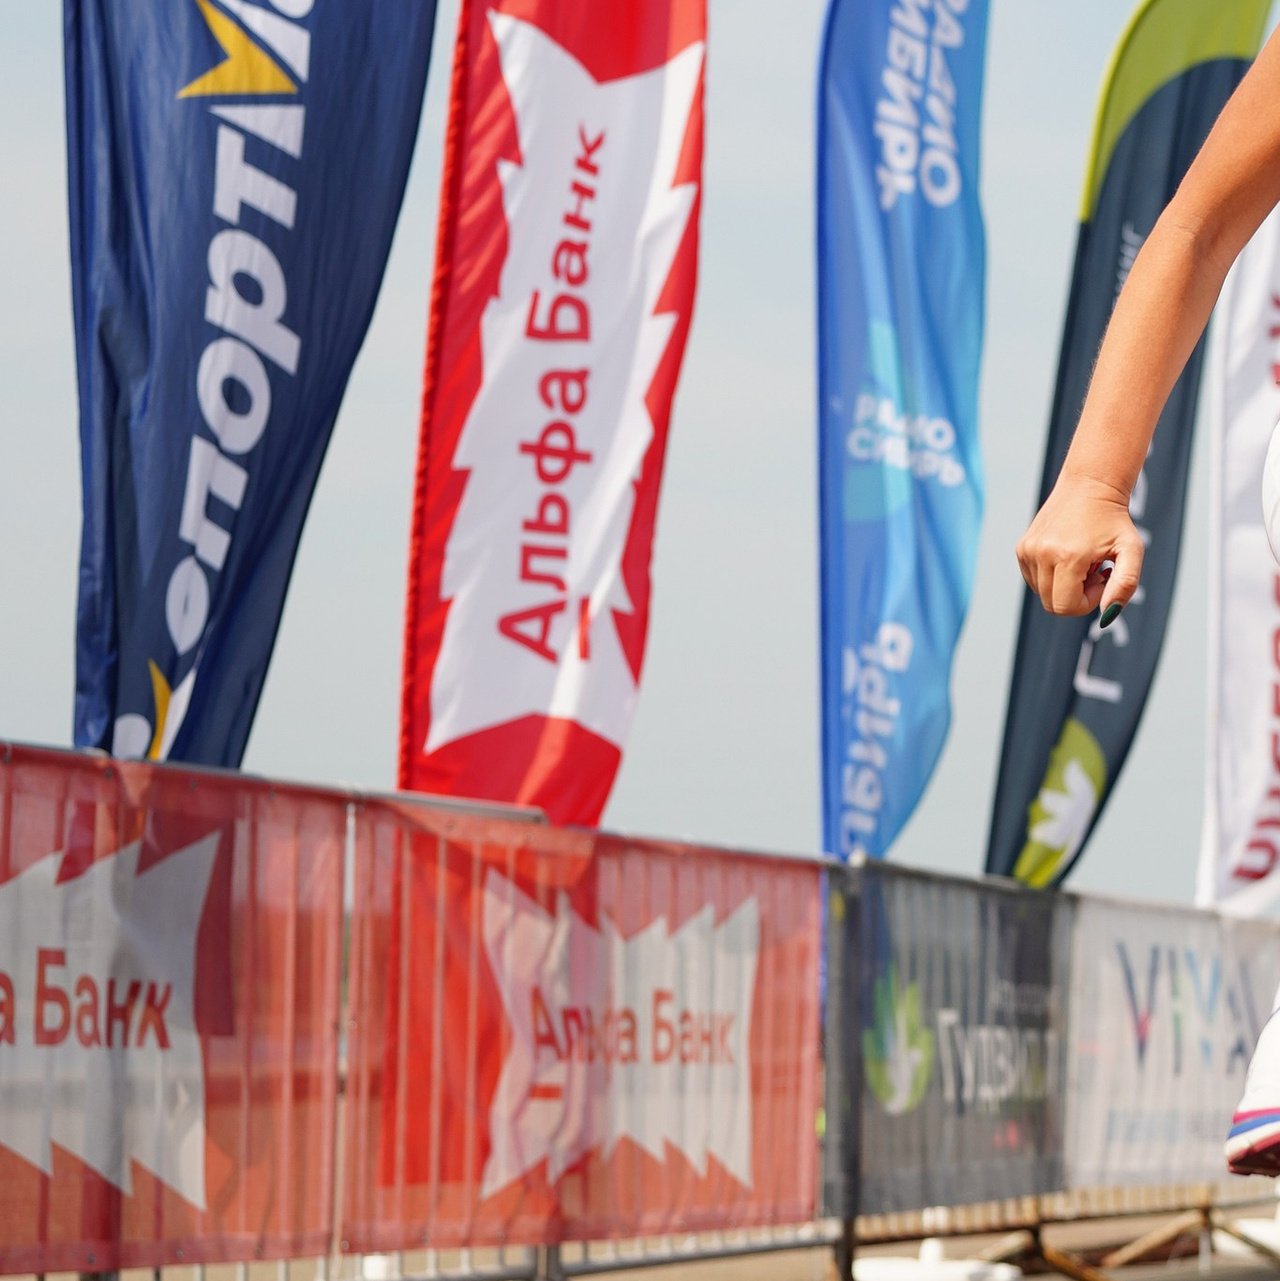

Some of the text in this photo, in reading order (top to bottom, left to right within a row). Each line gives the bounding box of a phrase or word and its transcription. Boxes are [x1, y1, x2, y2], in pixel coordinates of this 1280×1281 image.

[497, 124, 606, 665] Альфа Банк
[35, 947, 171, 1051] Банк
[652, 989, 735, 1065] Банк
[1115, 939, 1262, 1076] VIVA
